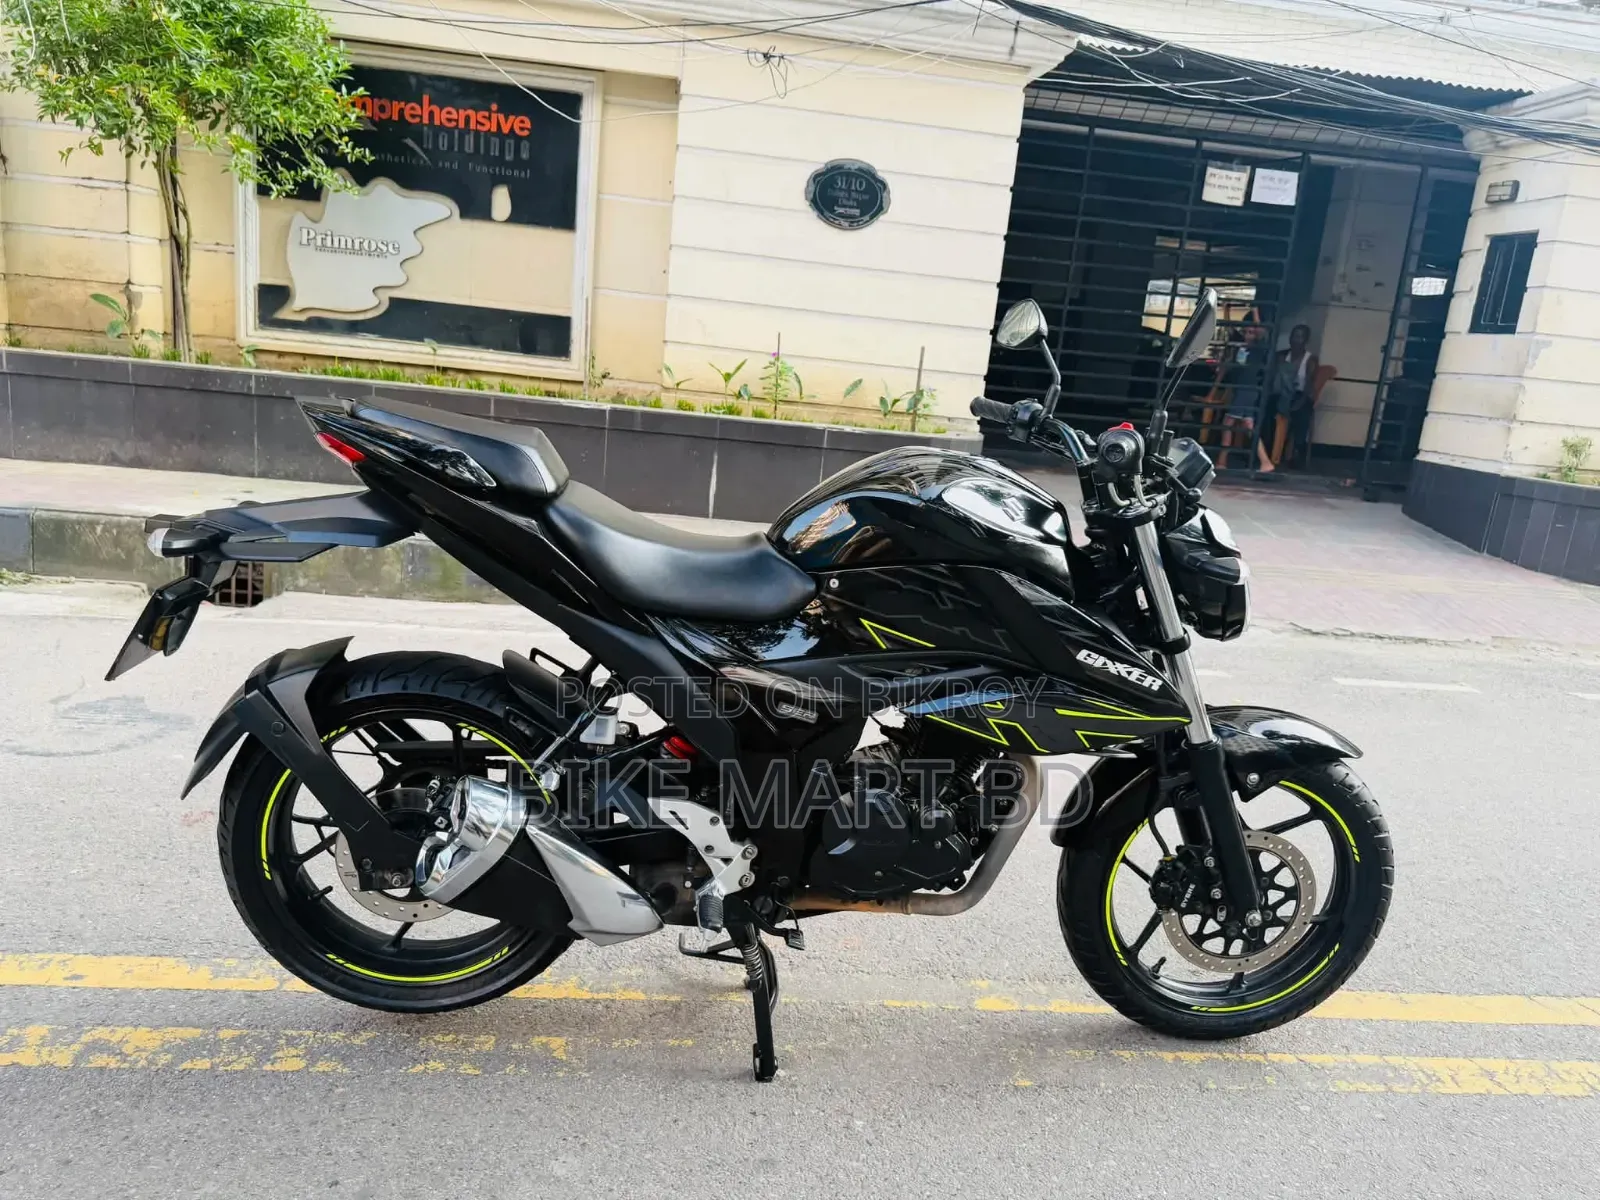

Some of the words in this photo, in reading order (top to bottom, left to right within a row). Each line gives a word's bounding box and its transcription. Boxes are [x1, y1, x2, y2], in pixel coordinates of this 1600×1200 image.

[345, 94, 531, 137] mprehensive
[437, 160, 459, 170] and
[468, 162, 530, 179] Functional
[300, 227, 400, 255] Primrose
[1075, 649, 1163, 691] GIXXER
